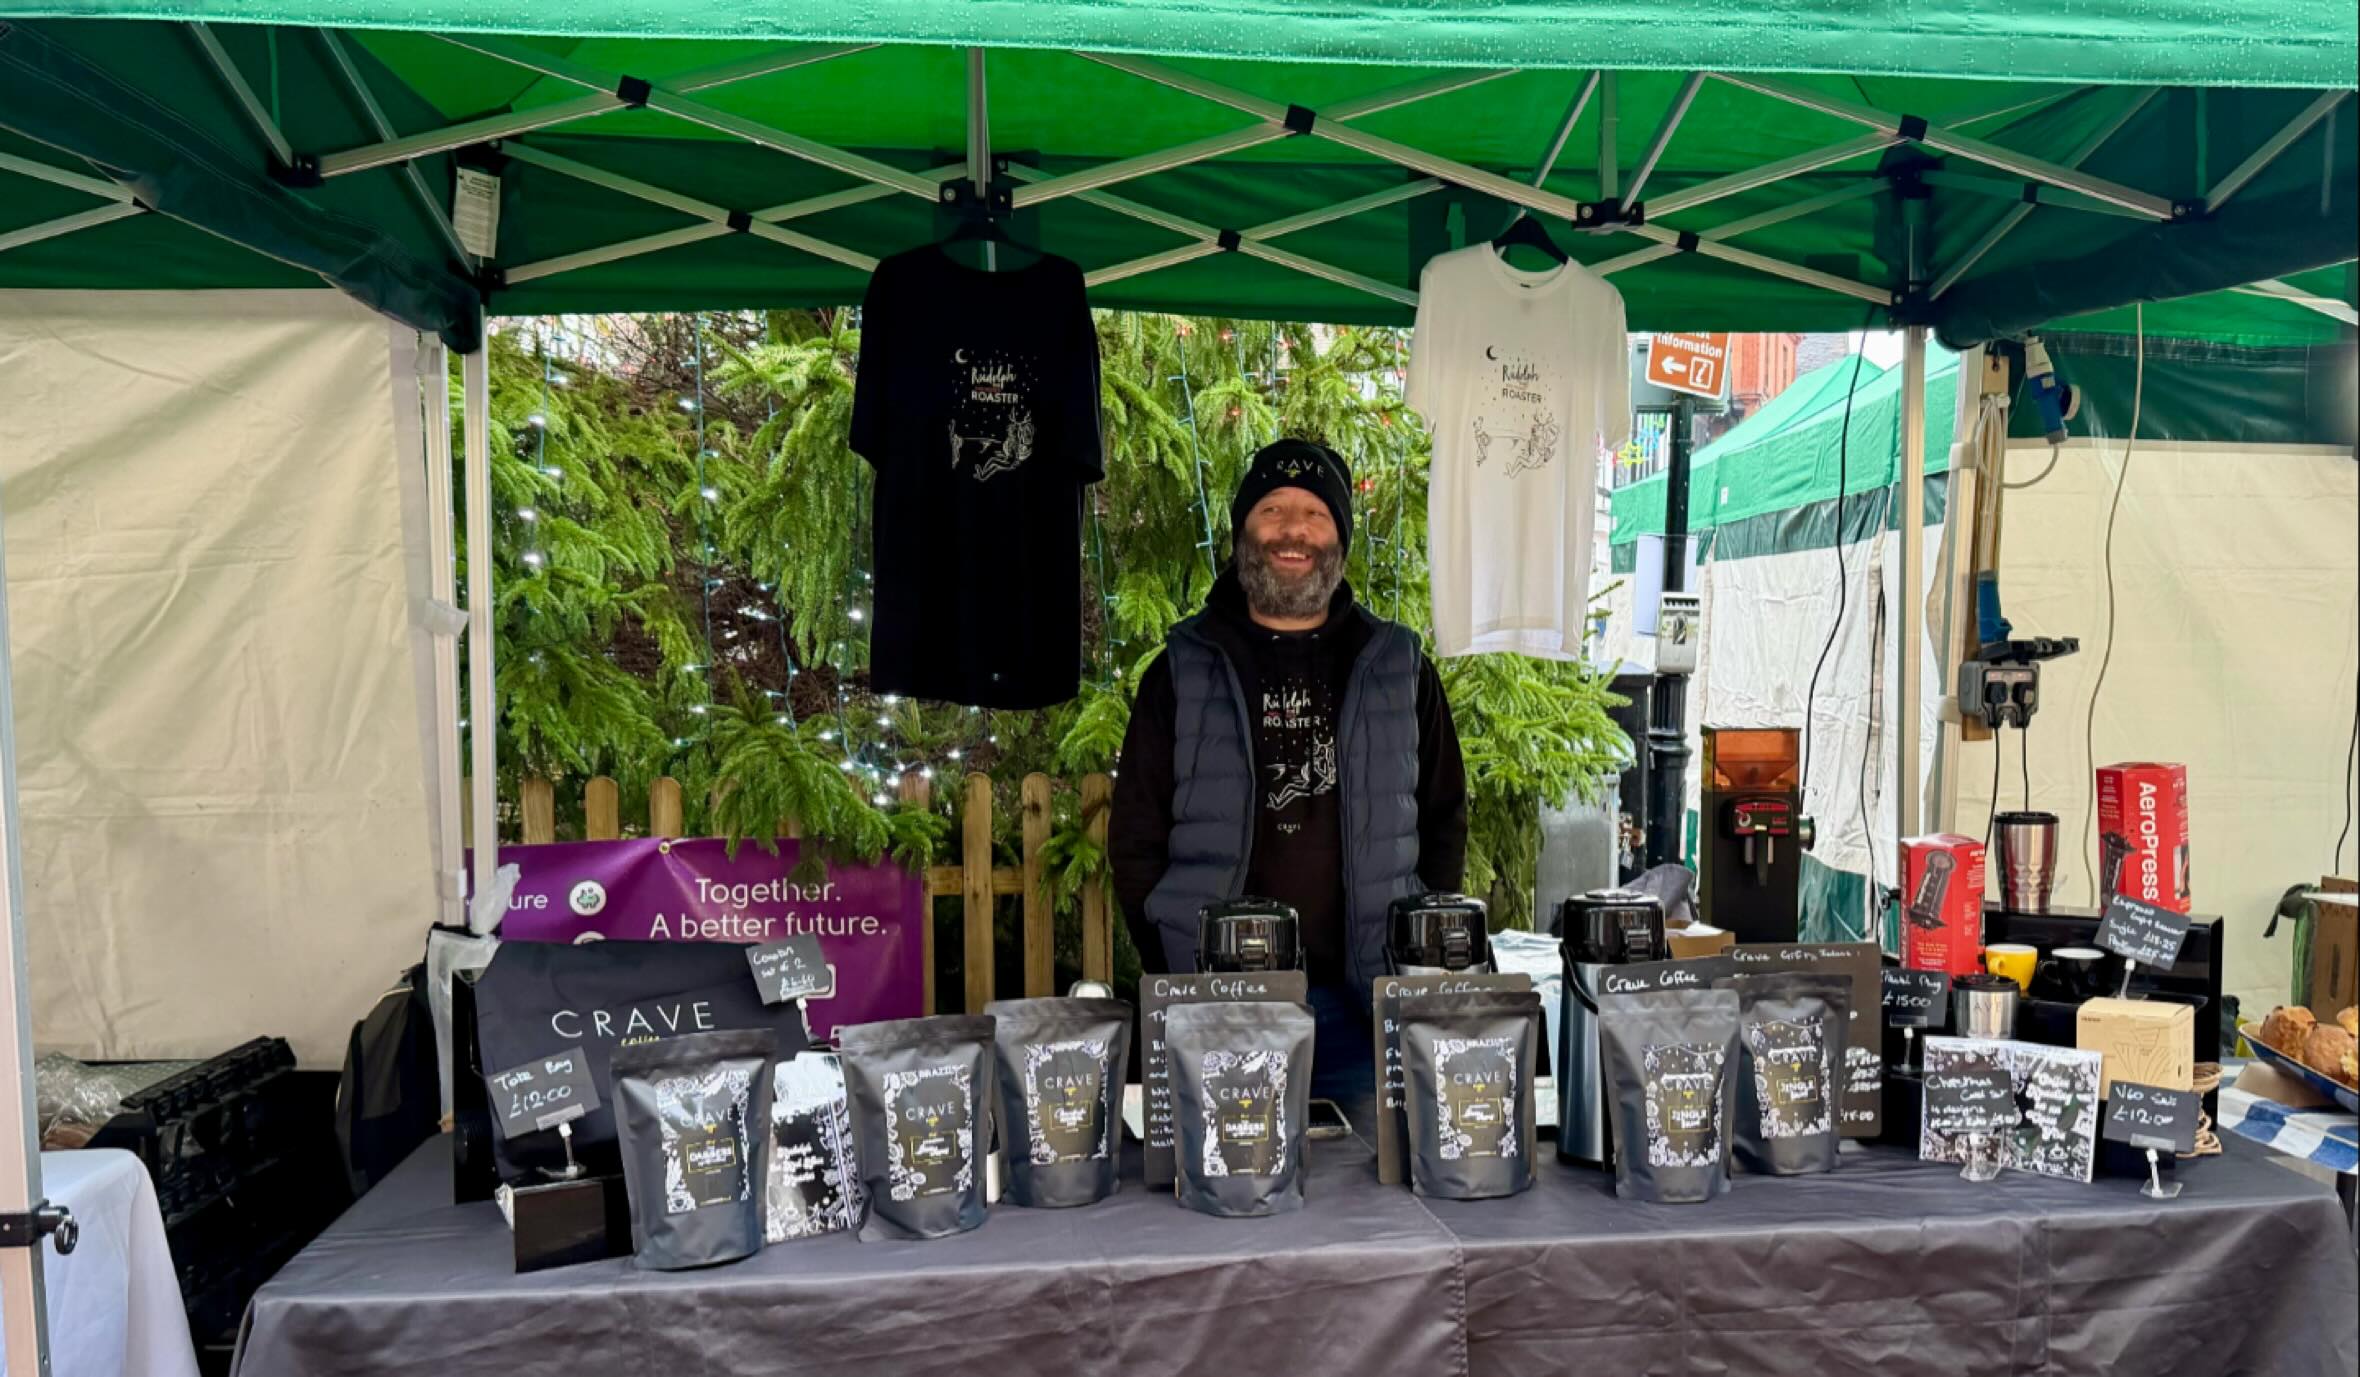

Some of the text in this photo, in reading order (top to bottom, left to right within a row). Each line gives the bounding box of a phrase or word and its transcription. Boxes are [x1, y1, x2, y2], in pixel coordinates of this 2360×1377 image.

[1656, 332, 1722, 358] Information
[971, 391, 1019, 404] ROASTER
[1502, 388, 1542, 403] ROASTER
[2139, 782, 2159, 900] AeroPress
[509, 893, 549, 910] ure
[695, 878, 842, 908] Together.
[649, 911, 888, 939] A better future.
[1660, 970, 1699, 986] Coffee
[1210, 978, 1268, 1000] Coffee
[551, 1001, 715, 1038] CRAVE
[494, 1058, 573, 1091] Tote Bag
[1044, 1073, 1094, 1090] CRAVE
[1453, 1071, 1503, 1085] CRAVE
[508, 1085, 572, 1119] £12.00
[1220, 1086, 1270, 1100] CRAVE
[679, 1107, 733, 1127] CRAVE
[905, 1100, 957, 1121] CRAVE
